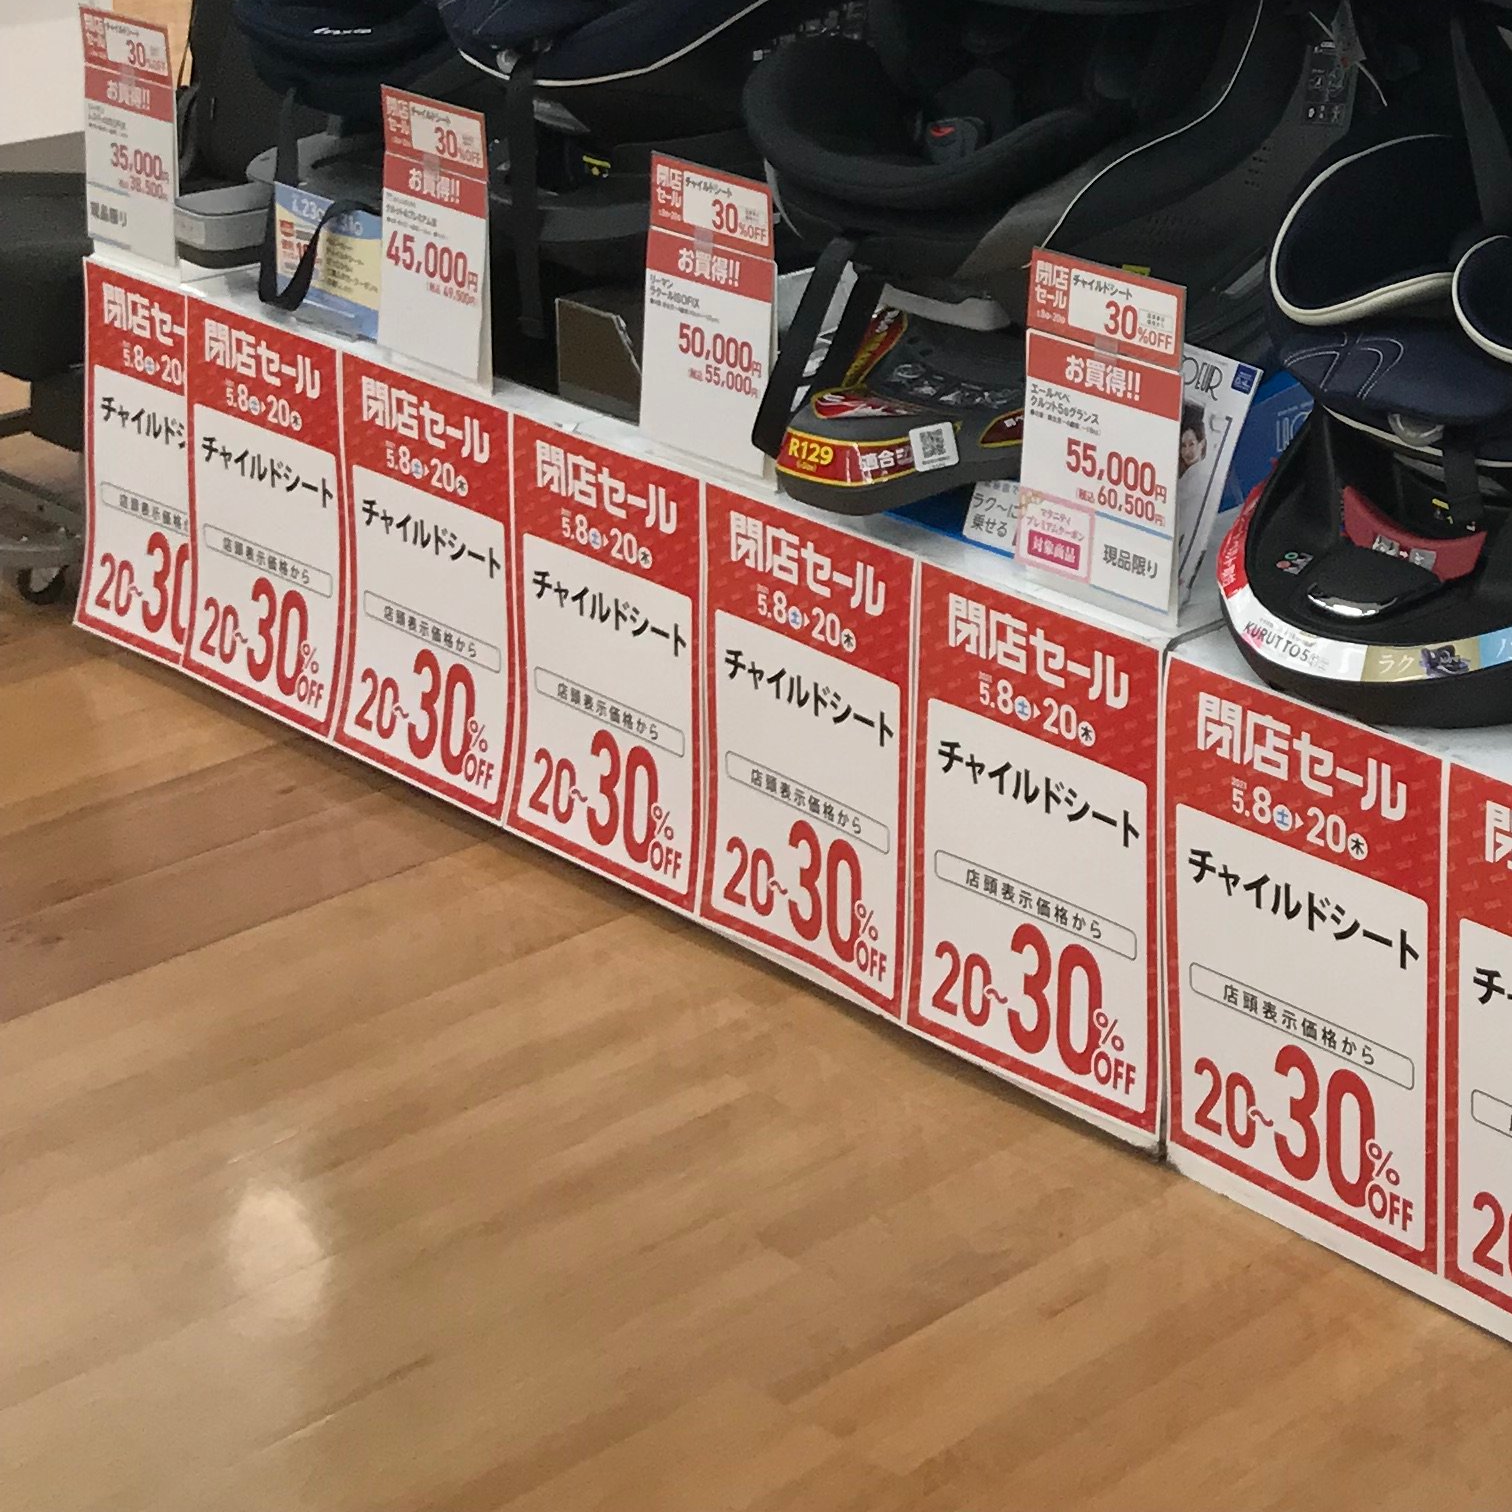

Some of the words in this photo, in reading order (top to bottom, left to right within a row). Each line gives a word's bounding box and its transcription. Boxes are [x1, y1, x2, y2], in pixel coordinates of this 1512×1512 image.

[110, 141, 170, 184] 35,000円
[407, 166, 461, 204] お買得!!
[386, 230, 479, 294] 45,000円
[677, 246, 741, 288] お買得!!
[1035, 259, 1069, 290] 閉店
[1072, 272, 1133, 300] チャイルドシート
[1034, 287, 1067, 311] セール
[203, 318, 321, 401] 閉店セール
[678, 322, 762, 379] 50,000円
[1064, 354, 1142, 401] お買得!!
[360, 374, 490, 464] 閉店セール
[201, 436, 334, 510] チャイルドシート
[788, 438, 834, 465] R129
[1065, 437, 1168, 505] 55,000円
[535, 438, 678, 536] 閉店セール
[360, 495, 501, 581] チャイルドシート
[970, 512, 1008, 539] 乗せる
[1032, 535, 1077, 564] 対象商品
[222, 534, 311, 586] 店頭表示価格から
[729, 510, 887, 617] 閉店セール
[1102, 543, 1158, 579] 現品限り
[383, 604, 478, 658] 店頭表示価格から
[532, 567, 688, 658] チャイルドシート
[947, 592, 1129, 711] 閉店セール
[1378, 652, 1417, 674] ラク
[556, 680, 660, 742] 店頭表示価格から
[724, 646, 895, 748] チャイルドシート
[1196, 691, 1408, 822] 閉店セール
[750, 766, 862, 837] 店頭表示価格から
[937, 739, 1141, 849] チャイルドシート
[965, 868, 1103, 941] 店頭表示価格から
[1187, 843, 1420, 972] チャイルドシート
[1223, 983, 1377, 1067] 店頭表示価格から
